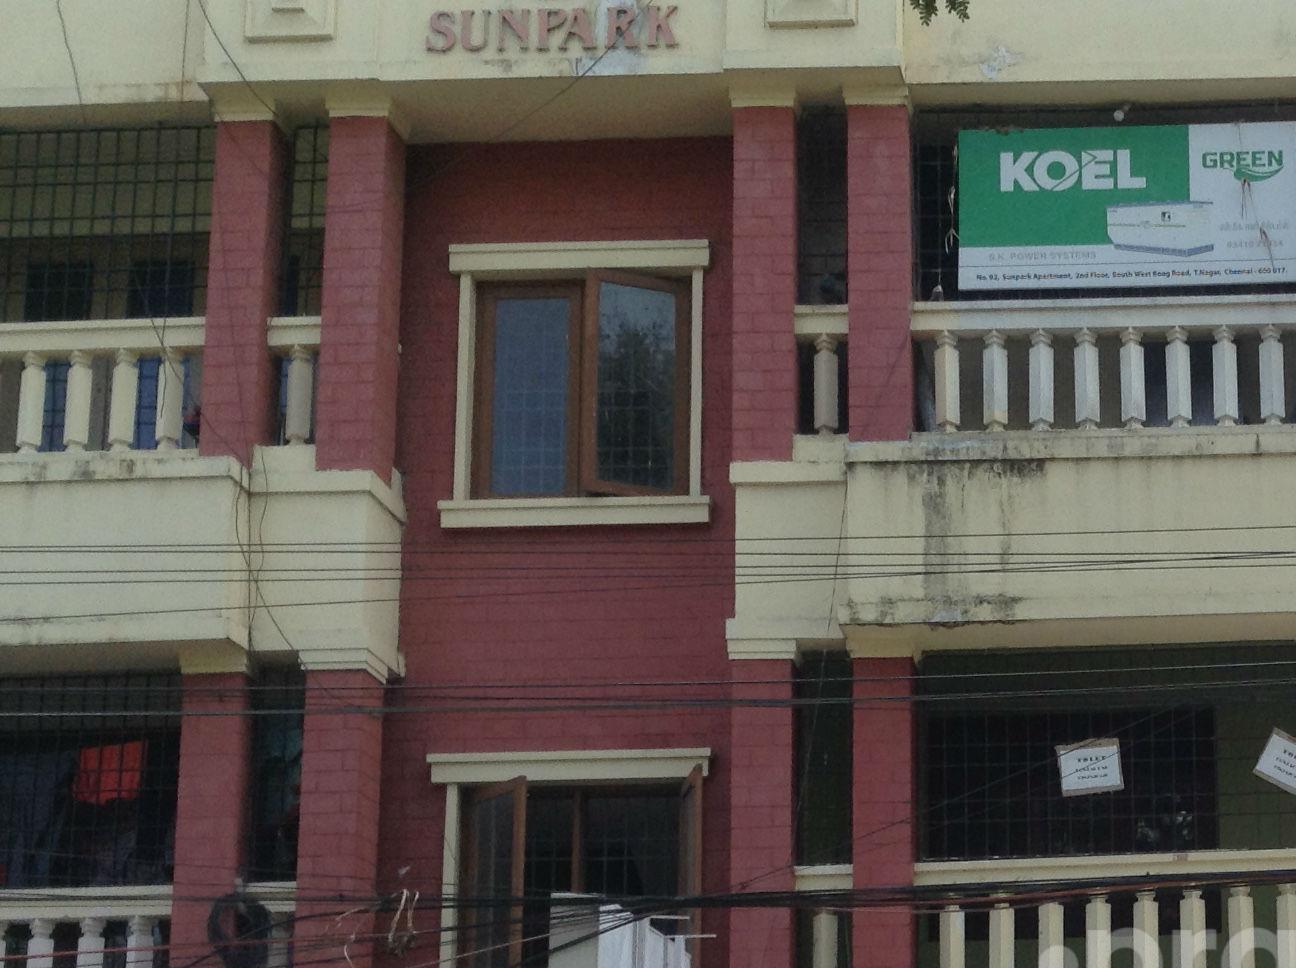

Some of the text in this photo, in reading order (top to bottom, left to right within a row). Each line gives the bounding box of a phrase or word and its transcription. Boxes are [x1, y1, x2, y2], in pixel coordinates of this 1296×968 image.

[425, 5, 679, 53] SUNPARK
[999, 149, 1147, 192] KOEL
[1201, 149, 1284, 169] GREEN
